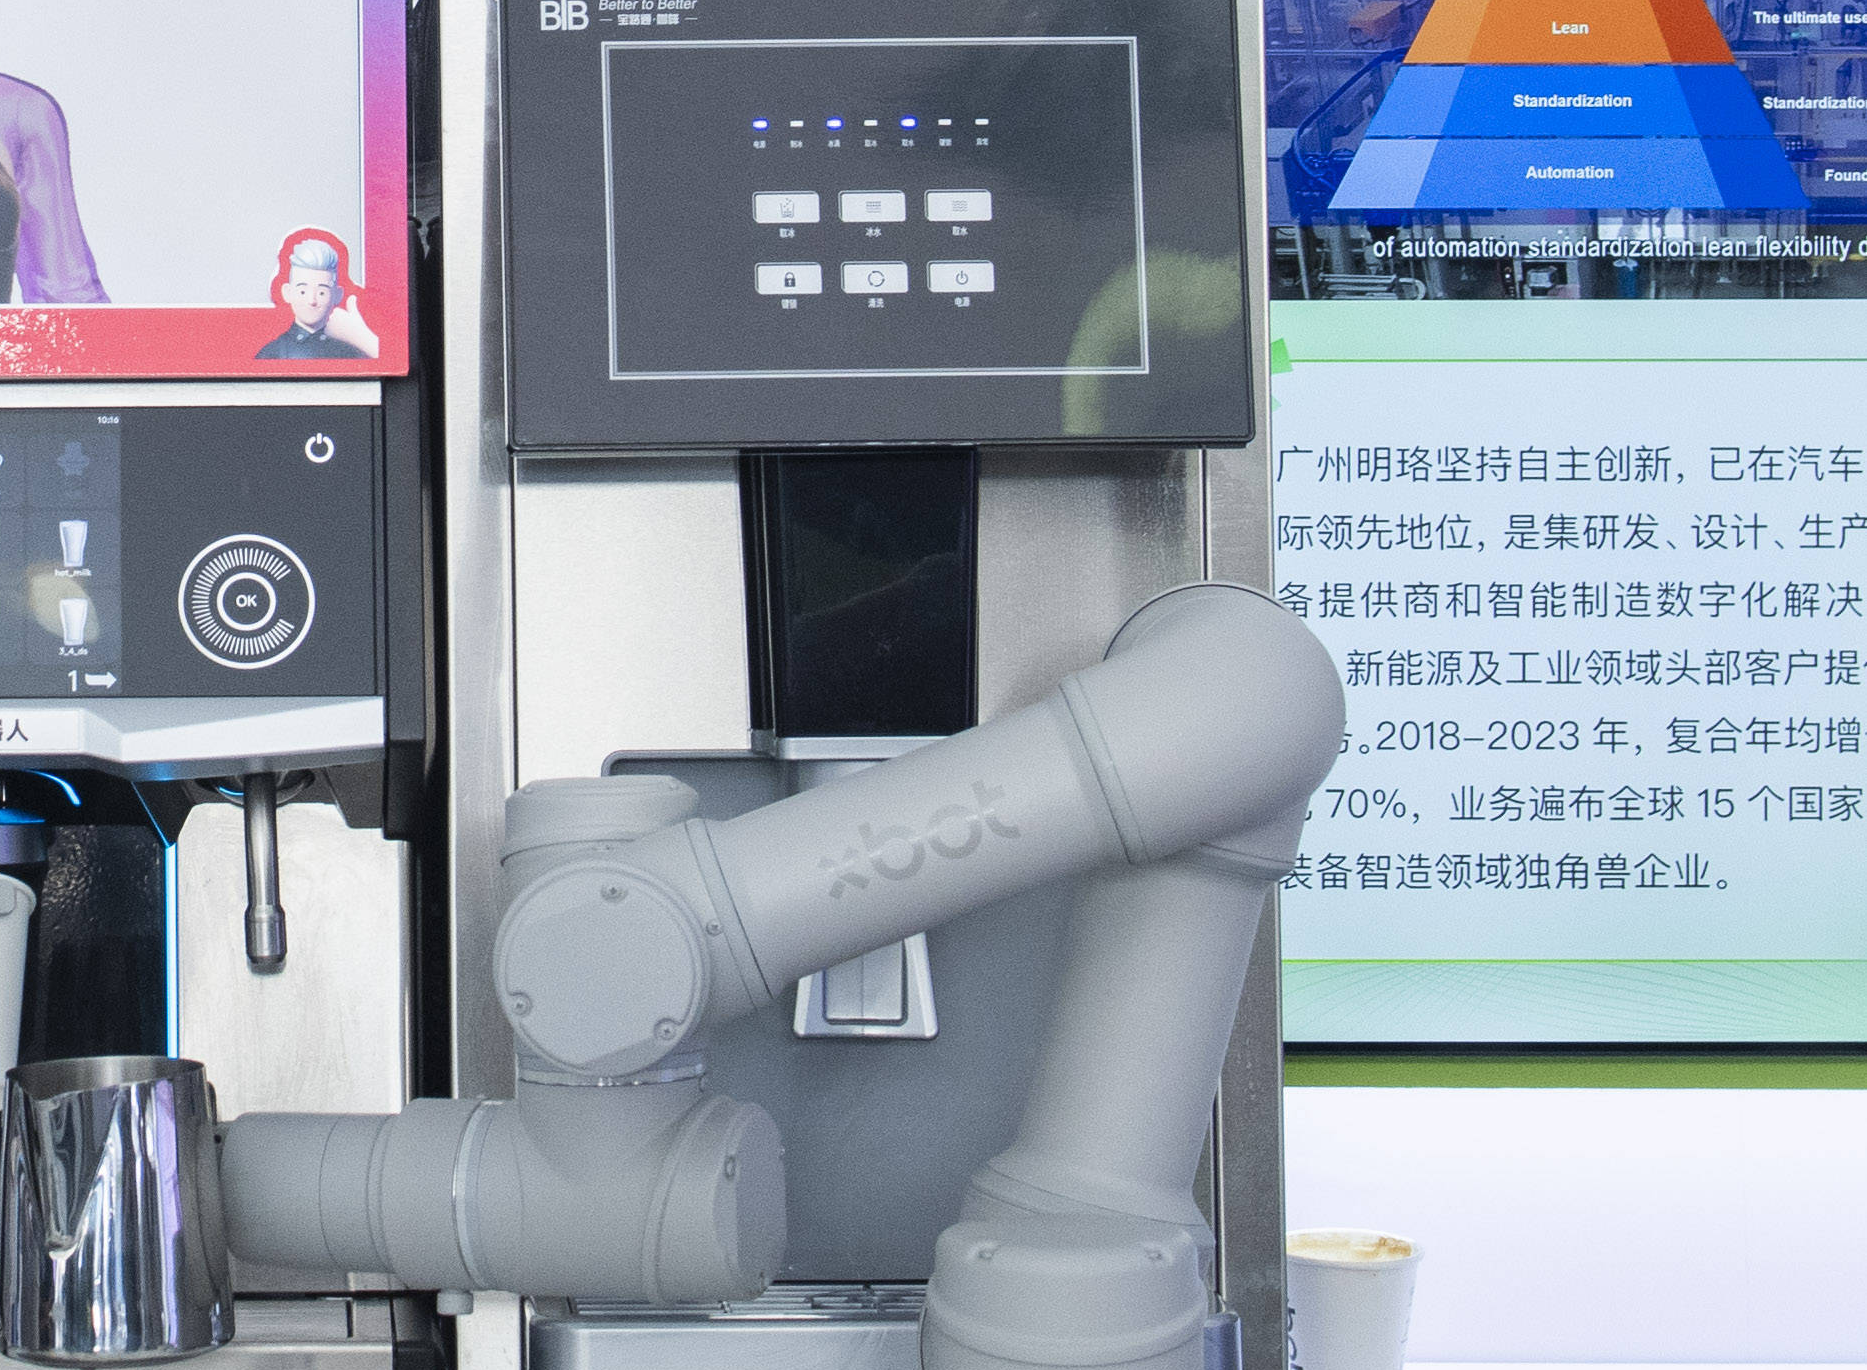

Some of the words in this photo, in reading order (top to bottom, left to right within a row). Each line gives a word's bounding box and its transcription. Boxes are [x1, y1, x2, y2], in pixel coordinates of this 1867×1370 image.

[1551, 20, 1589, 36] Lean
[1753, 10, 1781, 25] The
[1783, 10, 1841, 25] ultimate
[1512, 93, 1633, 111] Standardization
[1525, 165, 1615, 181] Automation
[1372, 237, 1398, 259] of
[1400, 237, 1521, 259] automation
[1527, 237, 1694, 259] standardization
[1701, 236, 1748, 259] lean
[1754, 235, 1852, 263] flexibility
[1275, 444, 1866, 485] 广州明珞坚持自主创新，已在汽车
[235, 594, 258, 609] OK
[1278, 581, 1864, 619] 备提供商和智能制造数字化解决
[67, 669, 79, 693] 1
[1346, 649, 1867, 688] 新能源及工业领域头部客户提
[1592, 716, 1867, 755] 年，复合年均增
[1696, 787, 1736, 818] 15
[1746, 785, 1864, 823] 个国家
[826, 779, 1023, 901] xbot
[1279, 851, 1731, 891] 装备智造领域独角兽企业。
